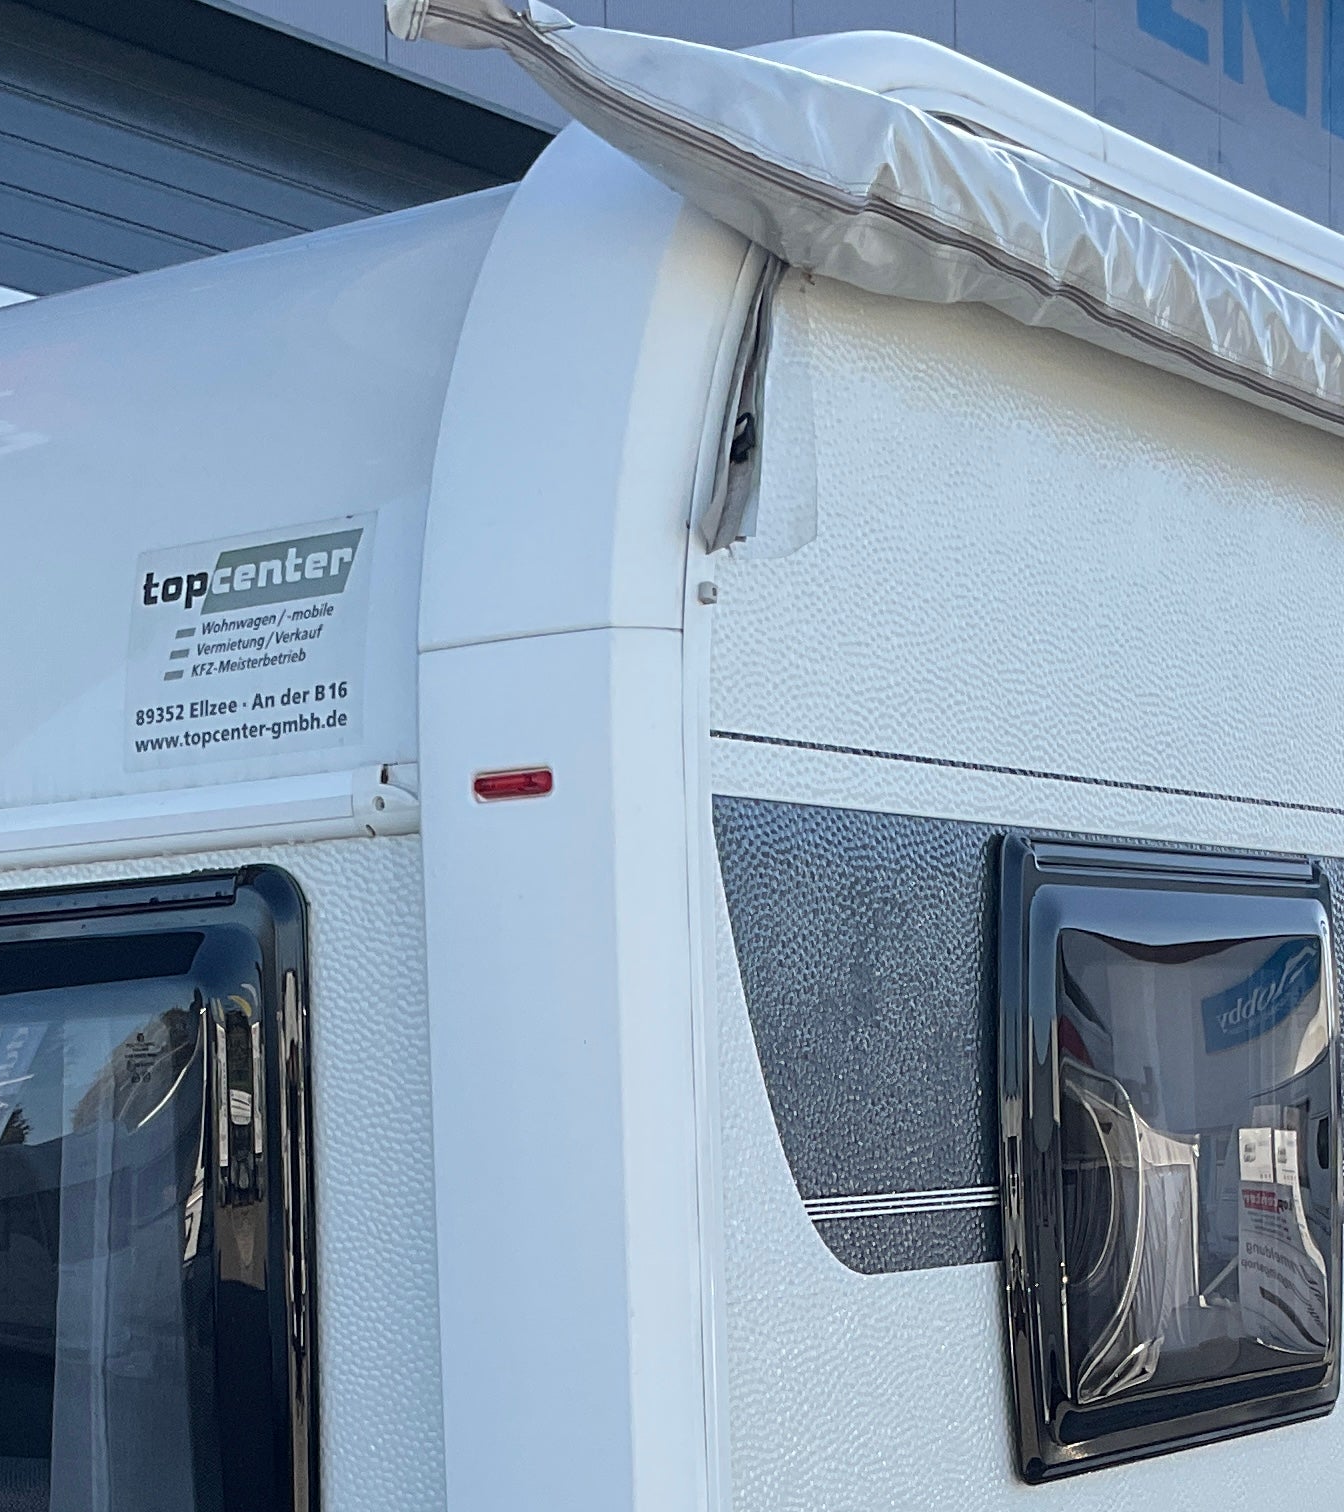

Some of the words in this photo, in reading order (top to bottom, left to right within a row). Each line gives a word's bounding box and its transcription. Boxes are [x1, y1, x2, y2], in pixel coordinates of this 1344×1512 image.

[143, 548, 353, 608] topcenter
[191, 649, 306, 678] KFZ-Meisterbetrieb
[136, 704, 184, 726] 89352
[190, 699, 238, 719] Ellzee
[252, 693, 275, 711] An
[280, 687, 310, 706] der
[135, 709, 347, 752] www.topcenter-gmbh.de
